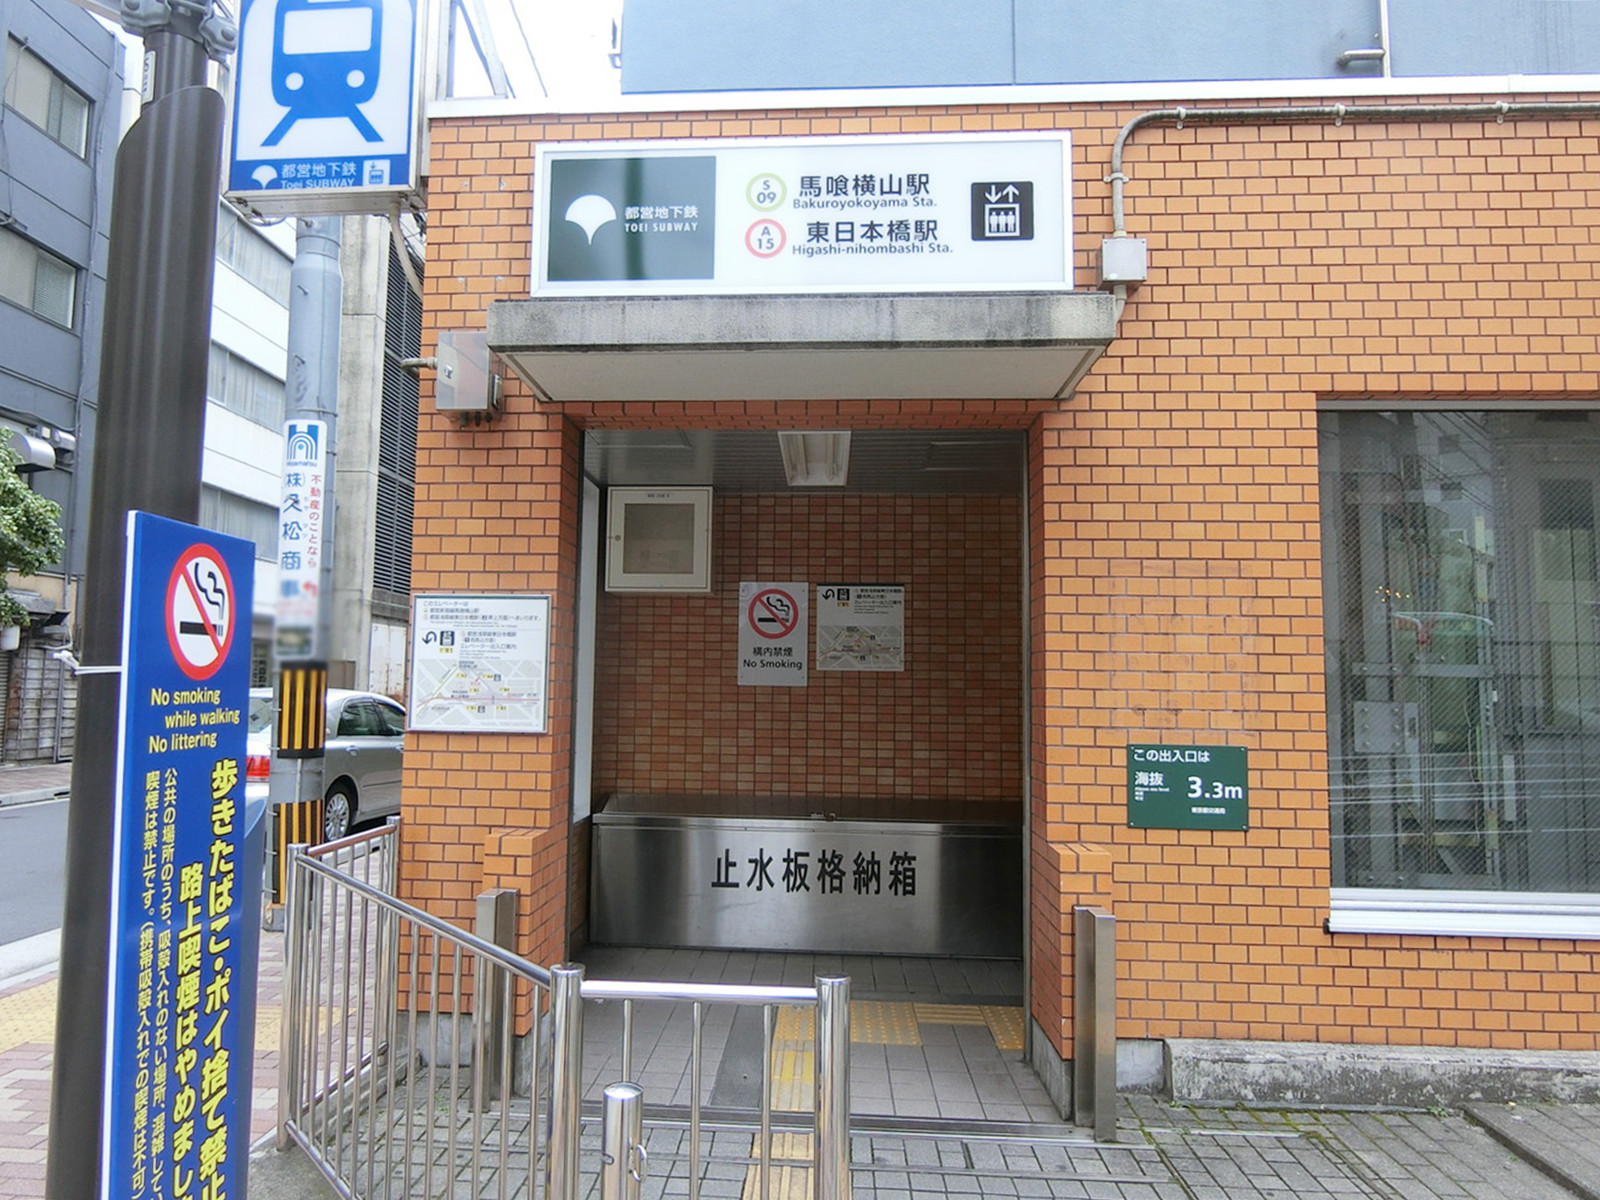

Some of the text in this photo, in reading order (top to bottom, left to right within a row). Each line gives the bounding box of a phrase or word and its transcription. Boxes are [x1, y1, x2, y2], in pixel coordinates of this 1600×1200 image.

[281, 161, 357, 179] 都営地下鉄
[281, 178, 355, 189] Toei SUBWAY
[763, 180, 771, 190] S
[799, 173, 930, 197] 馬喰横山駅
[756, 192, 776, 204] 09
[793, 196, 937, 211] Bakuroyokoyama Sta.
[625, 206, 699, 220] 都営地下鉄
[624, 222, 699, 233] TOEI SUBWAY
[761, 226, 771, 236] A
[806, 220, 938, 243] 東日本橋駅
[757, 238, 774, 250] 15
[792, 242, 953, 258] Higashi-nihombashi Sta.
[752, 647, 793, 658] 構内禁煙
[743, 659, 803, 671] No Smoking
[151, 687, 222, 706] No smoking
[165, 708, 241, 729] while walking
[148, 731, 218, 754] No littering
[1134, 749, 1210, 763] この出入口は
[1134, 771, 1164, 786] 海抜
[1187, 776, 1243, 799] 3.3m
[711, 847, 917, 896] 止水板格納箱
[172, 862, 204, 1200] 路上喫煙はやめまし
